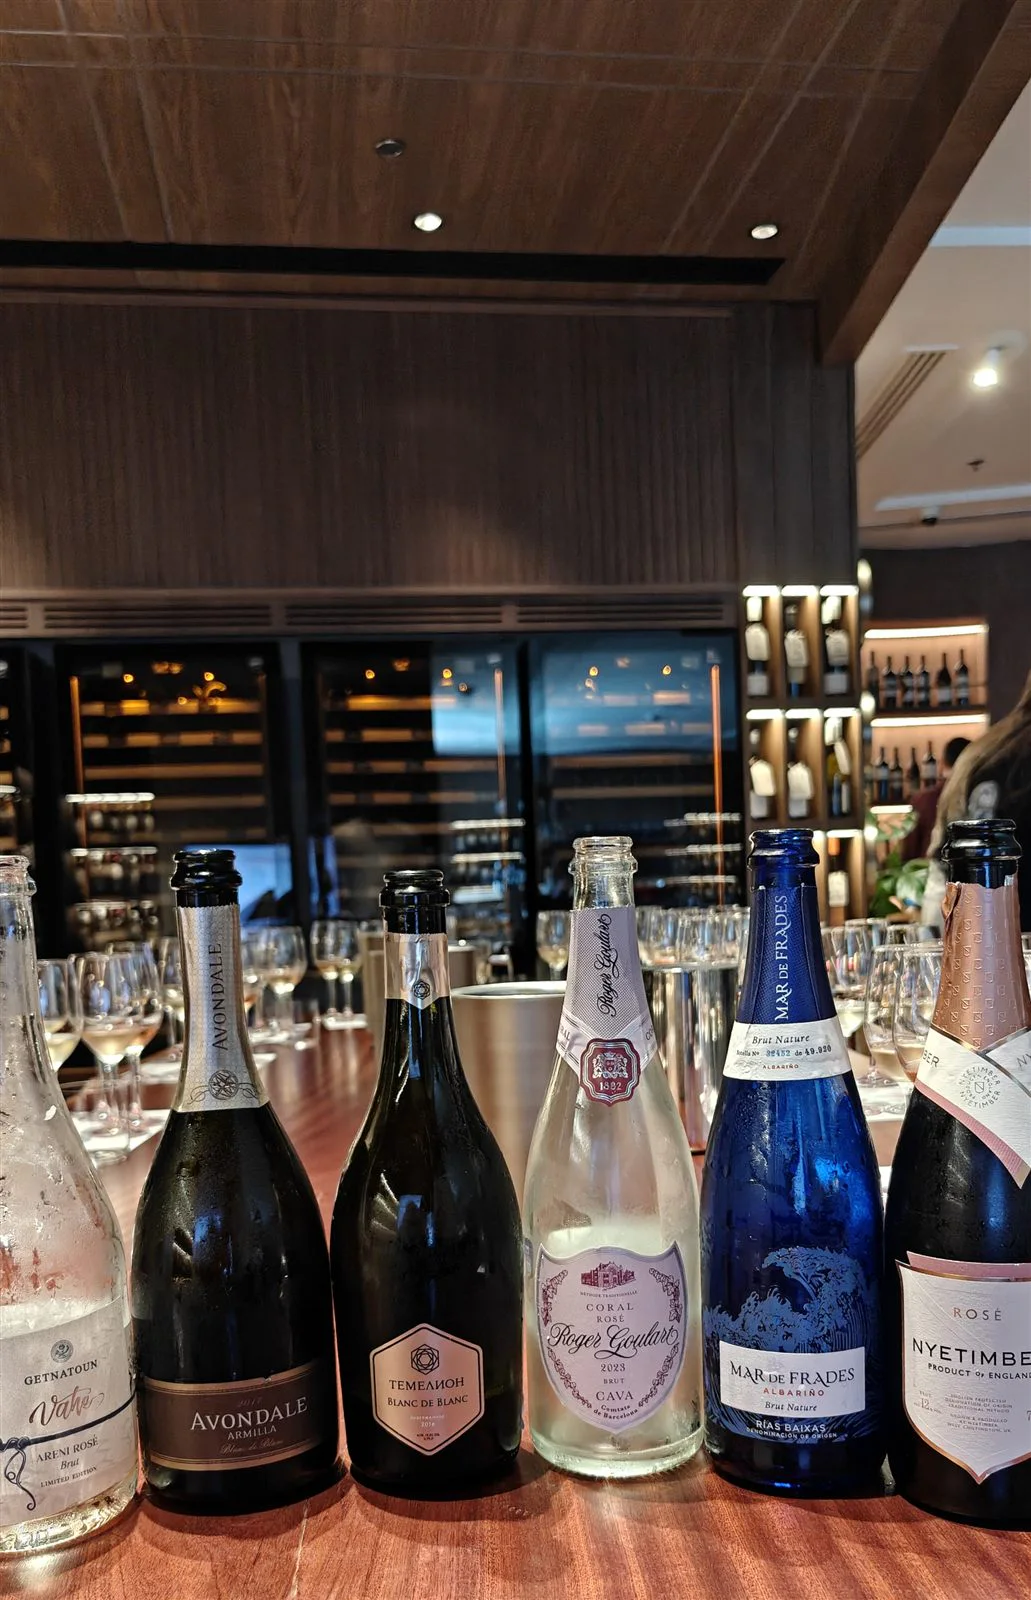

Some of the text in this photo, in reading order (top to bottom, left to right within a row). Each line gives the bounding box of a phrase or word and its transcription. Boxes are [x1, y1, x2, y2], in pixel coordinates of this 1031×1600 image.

[594, 913, 619, 1017] Roger Goulart
[774, 895, 792, 1021] MAR DE FRADES
[208, 943, 229, 1051] AVONDALE
[752, 1034, 810, 1045] Brut Nature
[586, 1302, 634, 1311] CORAL
[596, 1313, 625, 1323] ROSÉ
[953, 1307, 1002, 1321] ROSÉ
[547, 1321, 679, 1360] Roger Goulart
[24, 1359, 98, 1386] GETNATOUN
[600, 1362, 626, 1372] 2023
[730, 1360, 855, 1388] MAR DE FRADES
[927, 1362, 971, 1377] PRODUCT
[595, 1390, 634, 1401] CAVA
[763, 1387, 825, 1397] ALBARIÑO
[387, 1395, 468, 1408] BLANC DE BLANC
[765, 1401, 818, 1412] Brut Nature
[190, 1396, 308, 1431] AVONDALE
[228, 1425, 277, 1440] ARMILLA
[756, 1419, 827, 1433] RÍAS BAIXAS
[36, 1434, 99, 1463] ARENI ROSÉ
[60, 1458, 80, 1471] Brut
[40, 1465, 98, 1488] LIMITED EDITION
